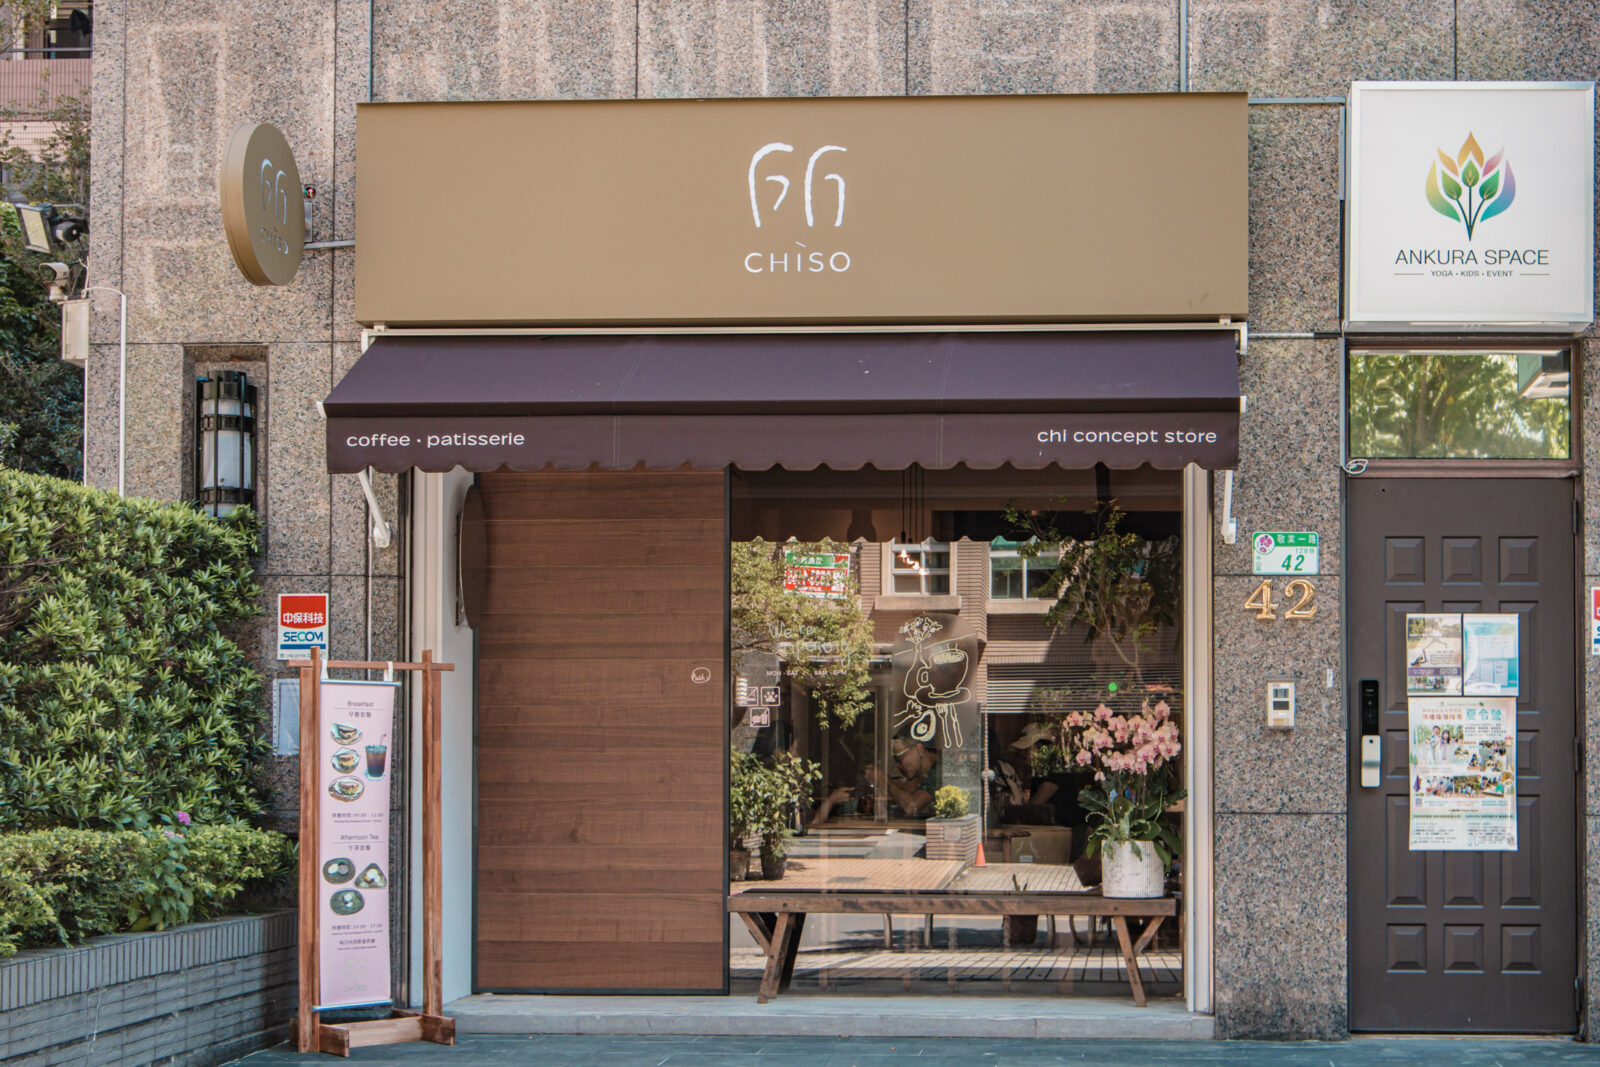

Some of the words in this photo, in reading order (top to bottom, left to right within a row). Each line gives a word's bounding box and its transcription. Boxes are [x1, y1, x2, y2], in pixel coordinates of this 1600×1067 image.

[1395, 249, 1478, 265] ANKURA
[1484, 249, 1549, 265] SPACE
[346, 433, 411, 447] coffee
[427, 432, 525, 448] patisserie
[1037, 429, 1067, 443] chi
[1073, 430, 1158, 445] concept
[1164, 430, 1217, 443] store
[1276, 534, 1316, 544] 敬業一路
[1281, 554, 1305, 571] 42
[1243, 579, 1318, 620] 42
[282, 612, 324, 624] 中保科技
[283, 631, 324, 642] SECOM
[1466, 708, 1502, 721] 夏令營
